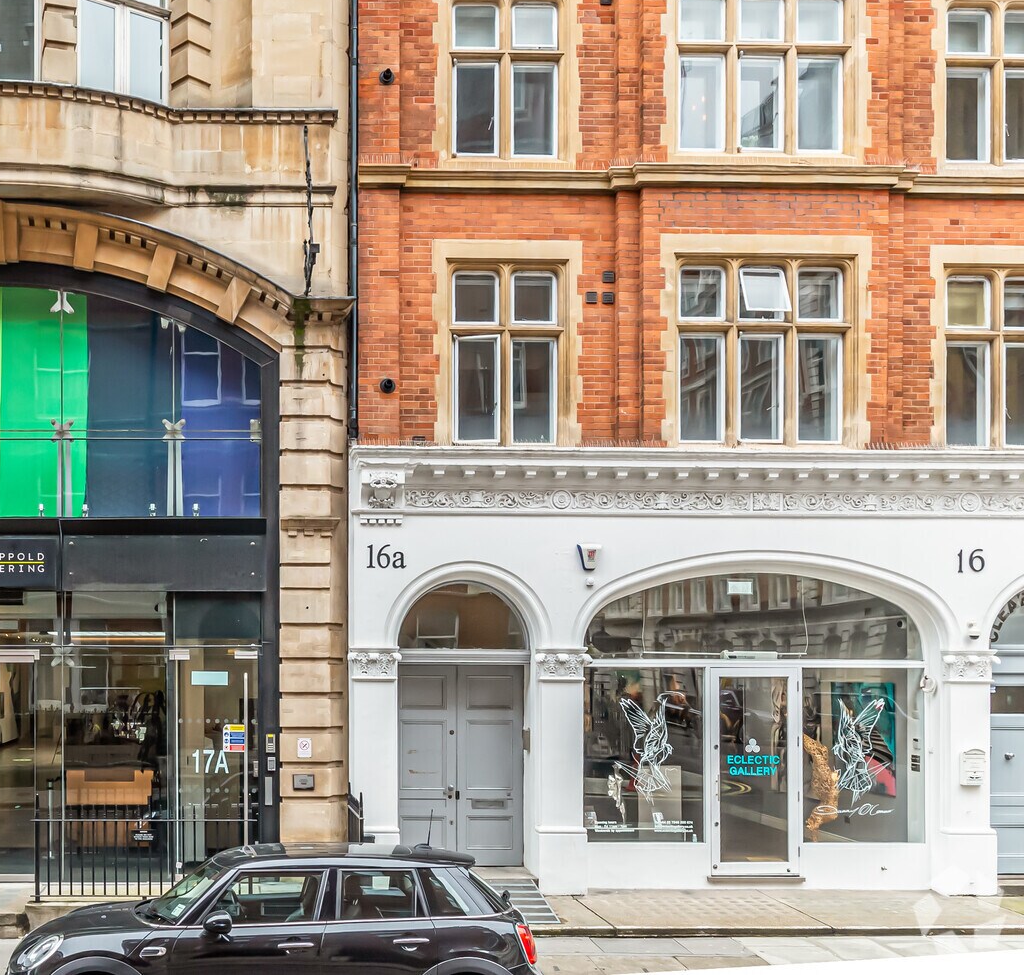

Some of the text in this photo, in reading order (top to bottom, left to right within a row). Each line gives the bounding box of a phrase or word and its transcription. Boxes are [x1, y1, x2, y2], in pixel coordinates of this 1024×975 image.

[366, 544, 407, 569] 16a
[957, 548, 985, 573] 16
[191, 749, 230, 774] 17A
[727, 755, 780, 765] ECLECTIC
[729, 766, 777, 776] GALLERY
